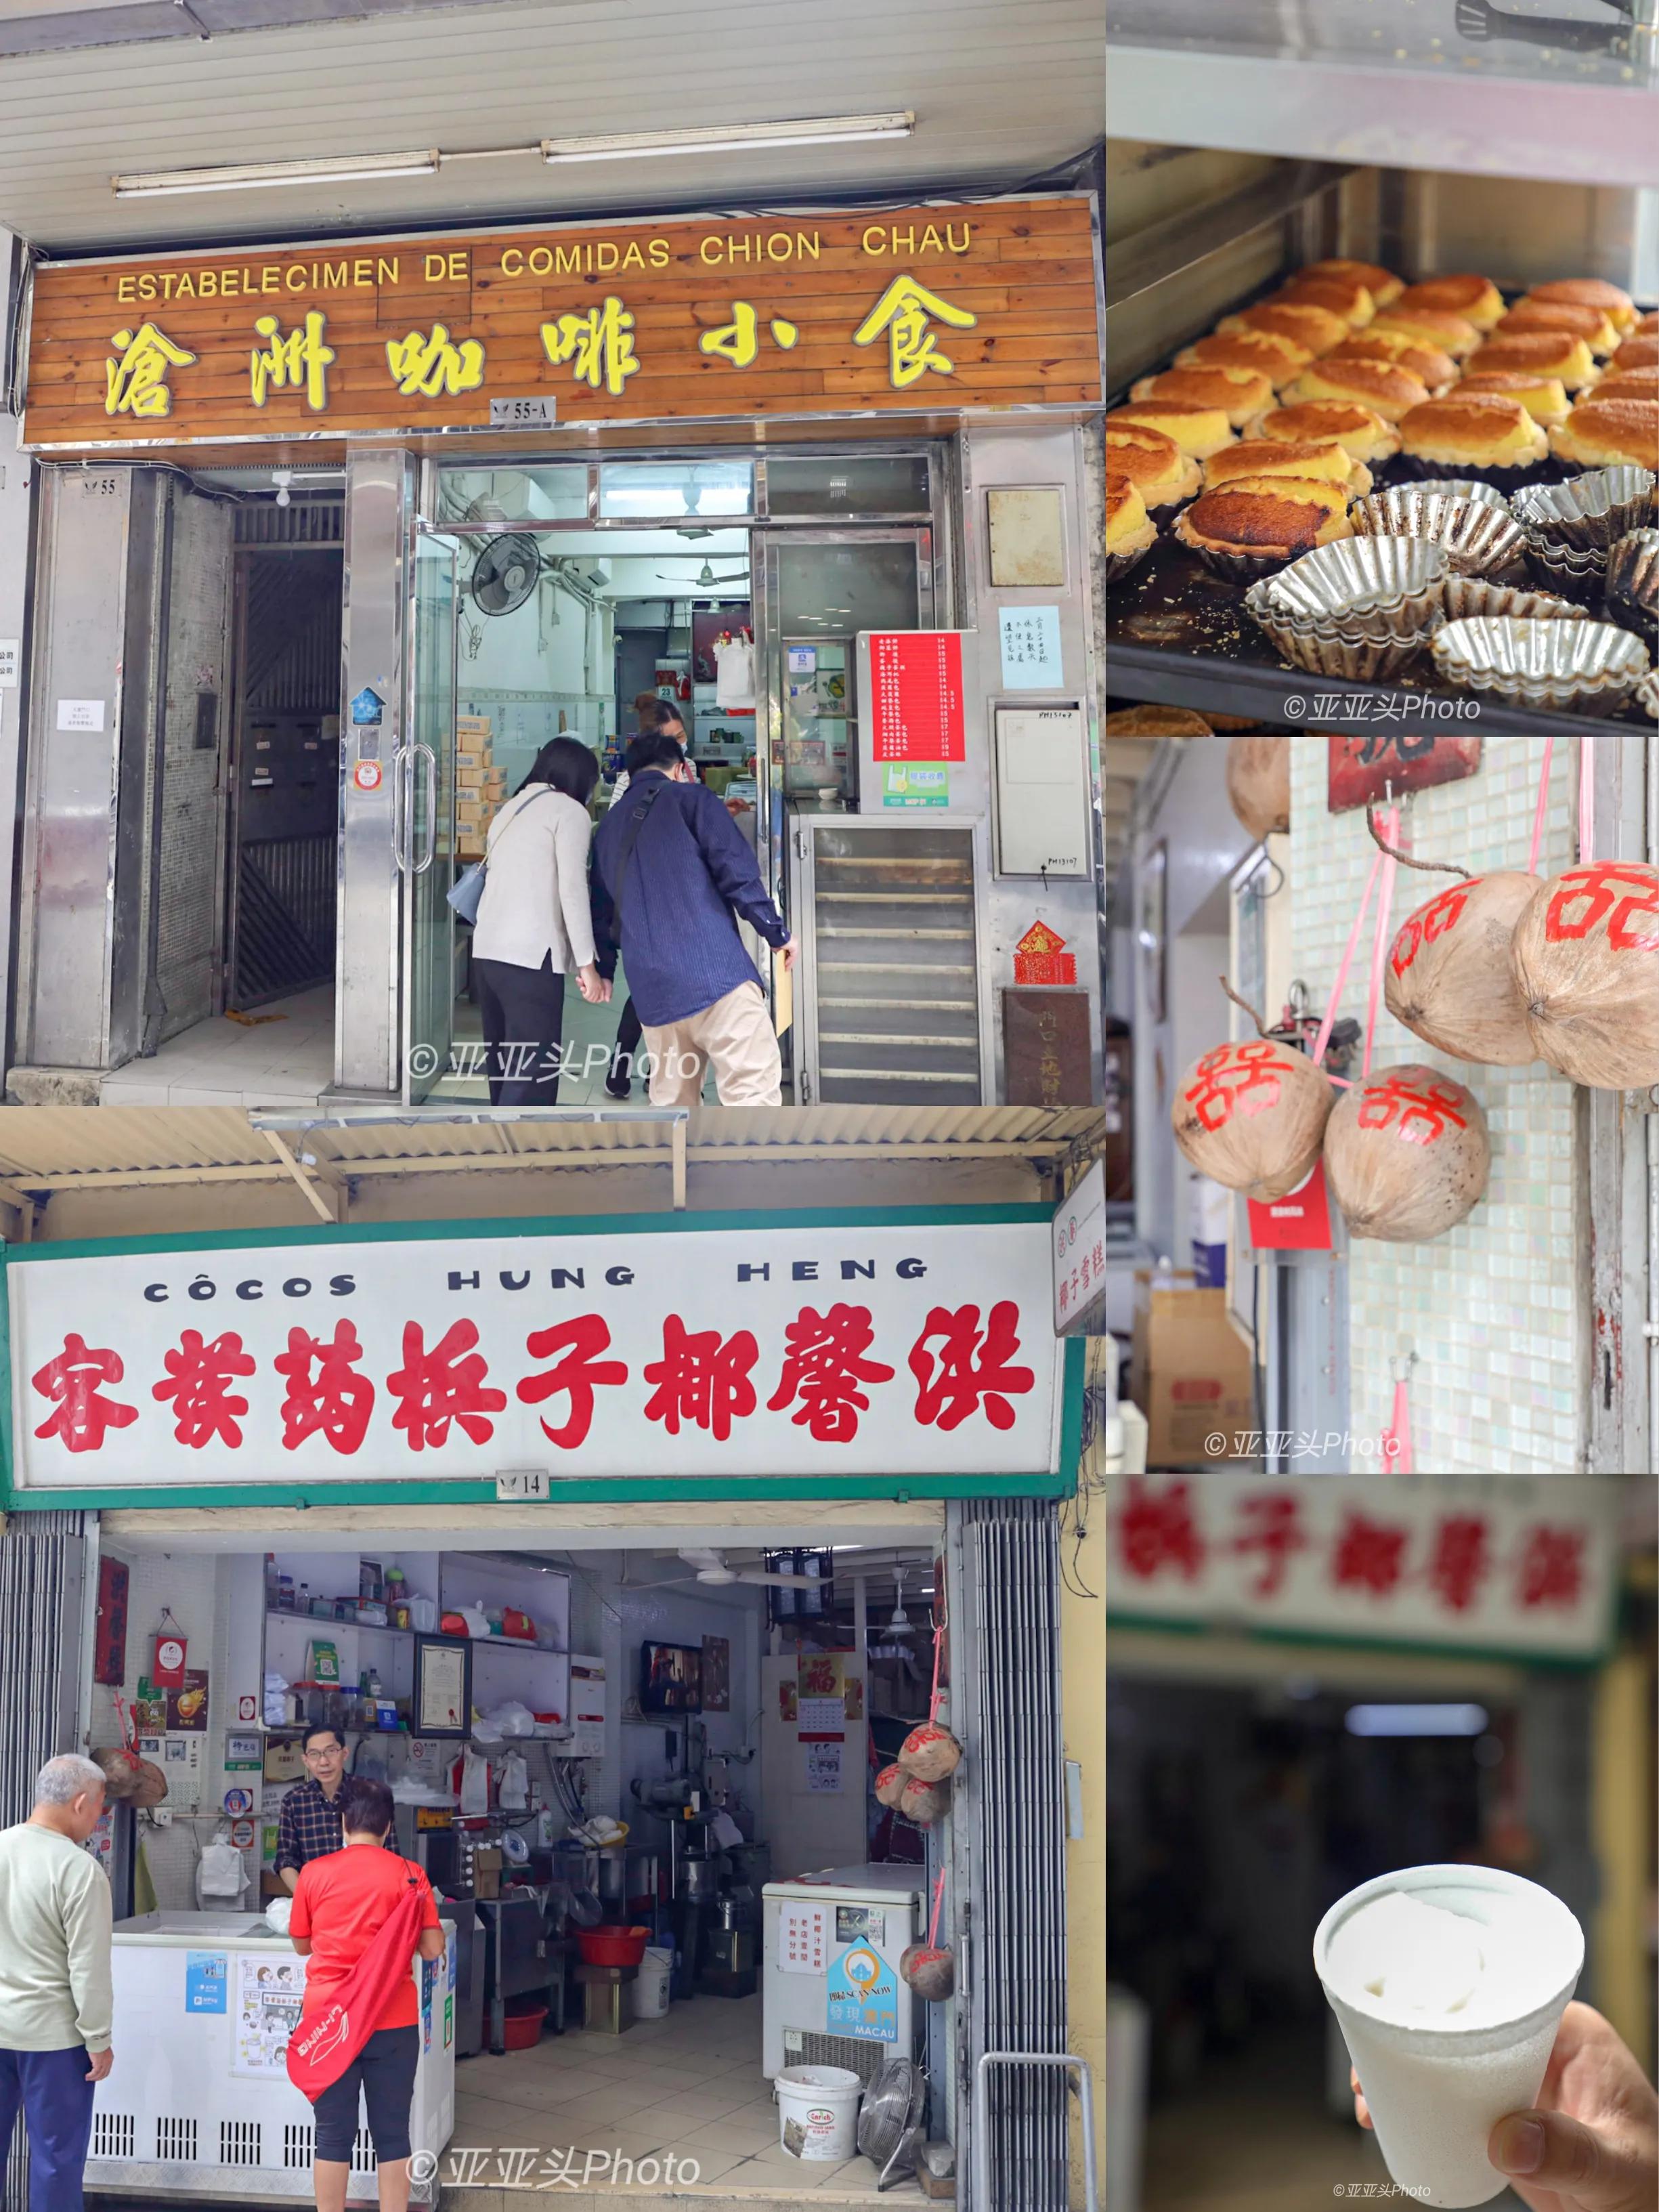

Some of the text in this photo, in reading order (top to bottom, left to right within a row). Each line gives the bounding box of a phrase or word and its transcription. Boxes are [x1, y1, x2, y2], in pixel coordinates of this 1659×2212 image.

[118, 224, 970, 302] ESTABELECIMEN DE COMIDAS CHION CHAU
[514, 401, 547, 419] 55-A
[101, 480, 115, 495] 55
[662, 688, 670, 696] 23
[144, 1258, 928, 1302] CÔCOS HUNG HENG
[521, 1474, 540, 1494] 14
[806, 1659, 836, 1693] 福
[813, 1913, 821, 1968] 鮮椰汁雪糕
[871, 1986, 891, 1995] NOW
[297, 2004, 343, 2057] LI-NING
[855, 2024, 895, 2039] MACAU
